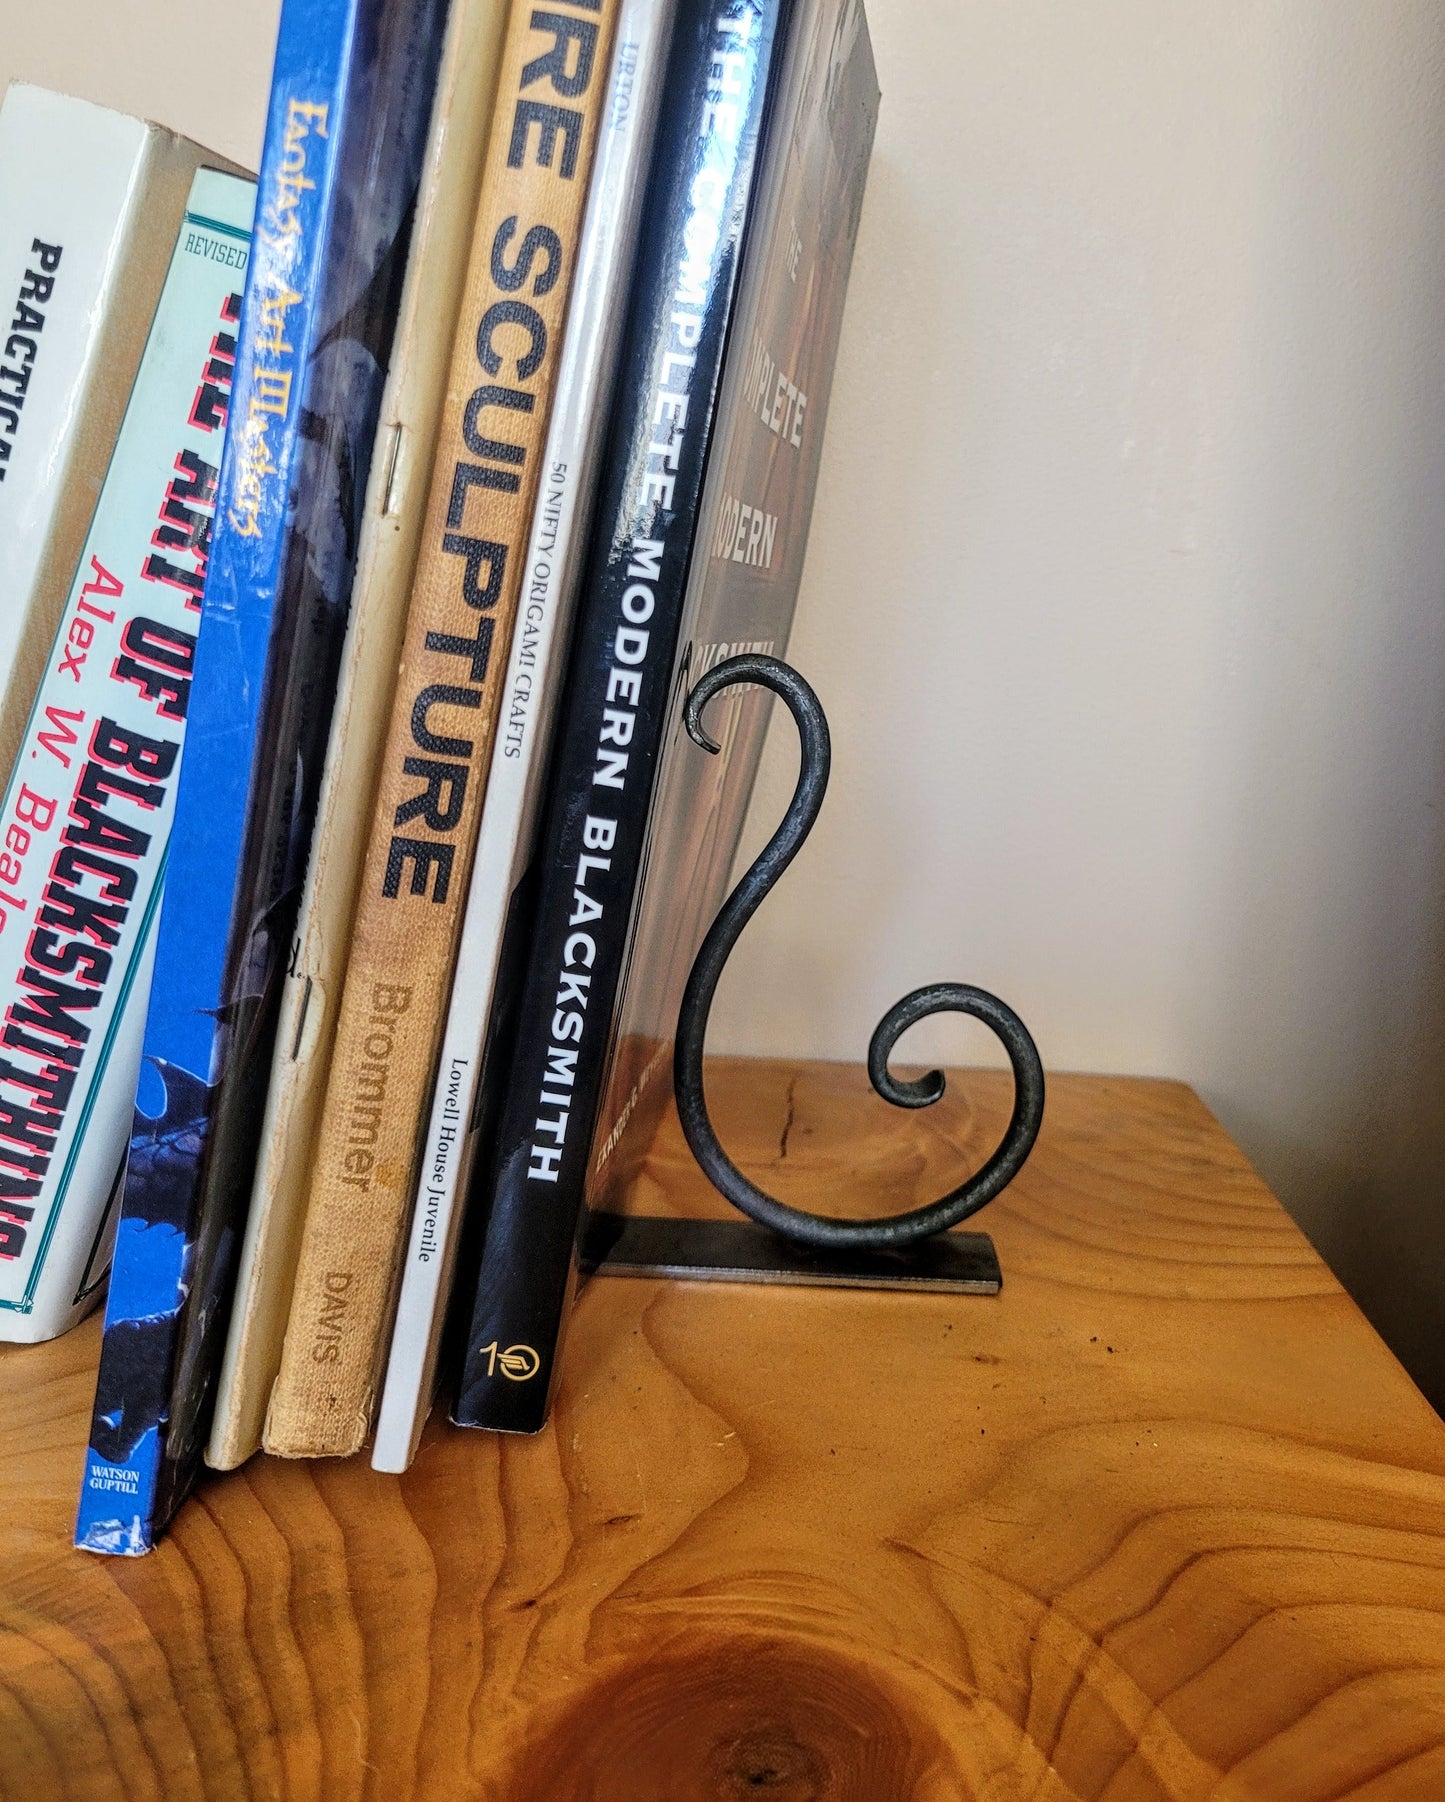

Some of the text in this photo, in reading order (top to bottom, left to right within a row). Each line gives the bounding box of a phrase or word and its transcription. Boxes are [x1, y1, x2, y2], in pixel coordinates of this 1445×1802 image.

[0, 238, 63, 482] PRACTIC
[185, 232, 248, 270] REVISED
[227, 98, 330, 538] Fantasy Art Masters
[640, 168, 728, 512] COMPLETE
[110, 616, 198, 722] OF
[382, 215, 562, 905] SCULPTURE
[504, 462, 568, 759] 50 NIFTY ORIGAMI CRAFTS
[592, 537, 666, 791] MODERN
[0, 555, 125, 935] Alex W. Beal
[342, 982, 411, 1193] Brommer
[527, 814, 618, 1184] BLACKSMITH
[418, 1057, 469, 1264] Lowell House Juvenile
[312, 1271, 354, 1366] DAVIS
[89, 1477, 139, 1494] GUPTILL
[92, 1465, 140, 1482] WATSON
